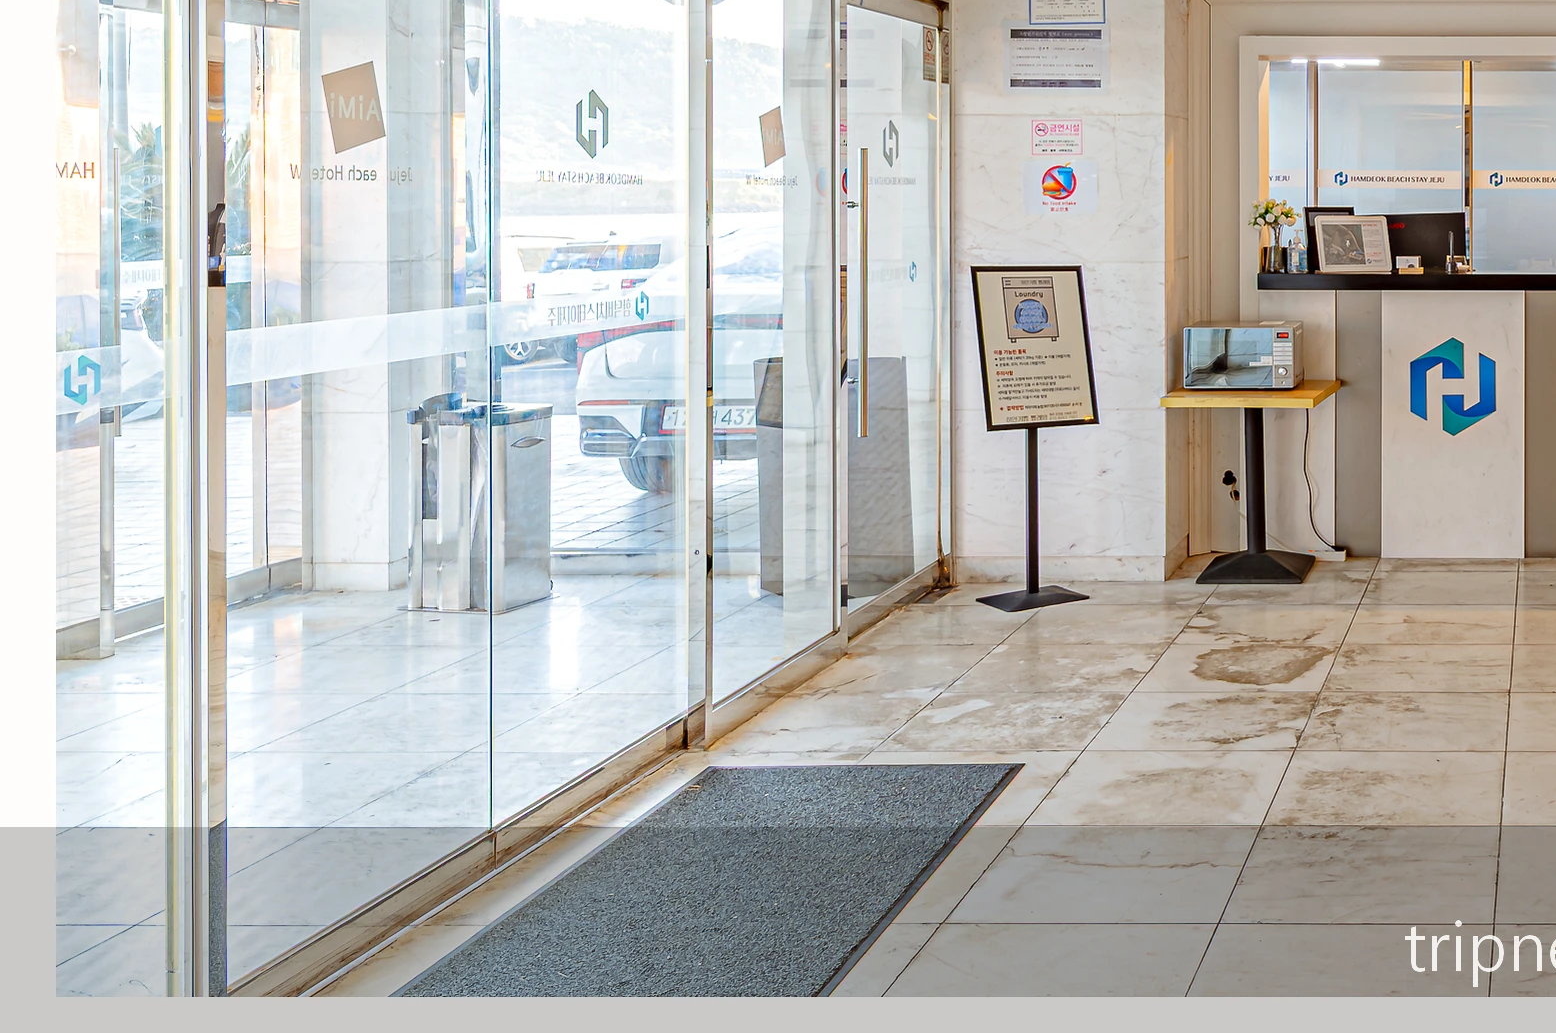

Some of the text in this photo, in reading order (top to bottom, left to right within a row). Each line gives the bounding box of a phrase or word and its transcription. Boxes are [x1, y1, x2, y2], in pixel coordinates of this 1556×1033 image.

[1274, 174, 1291, 183] JEJU
[1350, 175, 1445, 183] HAMDEOK BEACH STAY JEJU
[1505, 176, 1541, 184] HAMDEOK
